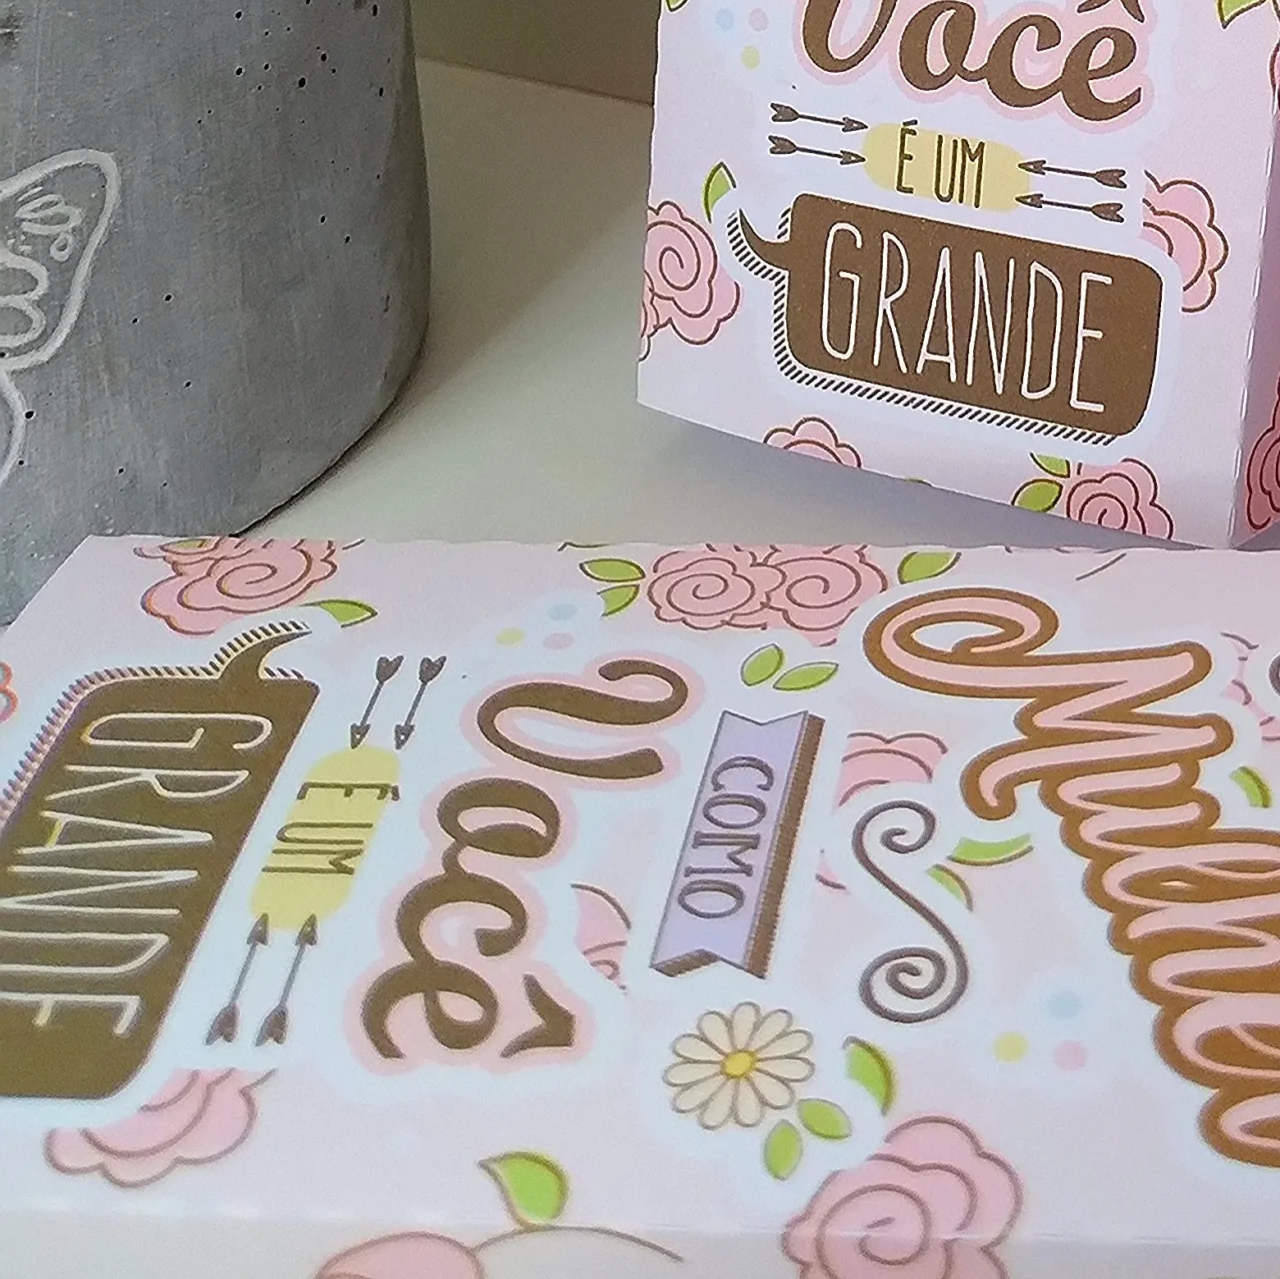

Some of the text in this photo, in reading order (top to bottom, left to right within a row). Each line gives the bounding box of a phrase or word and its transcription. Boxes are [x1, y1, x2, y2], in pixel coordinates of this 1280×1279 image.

[898, 120, 986, 209] É UM
[821, 222, 1113, 412] GRANDE
[0, 712, 273, 1037] GRANDE
[262, 820, 376, 876] UM
[362, 659, 688, 1059] Você
[677, 755, 775, 919] COMO
